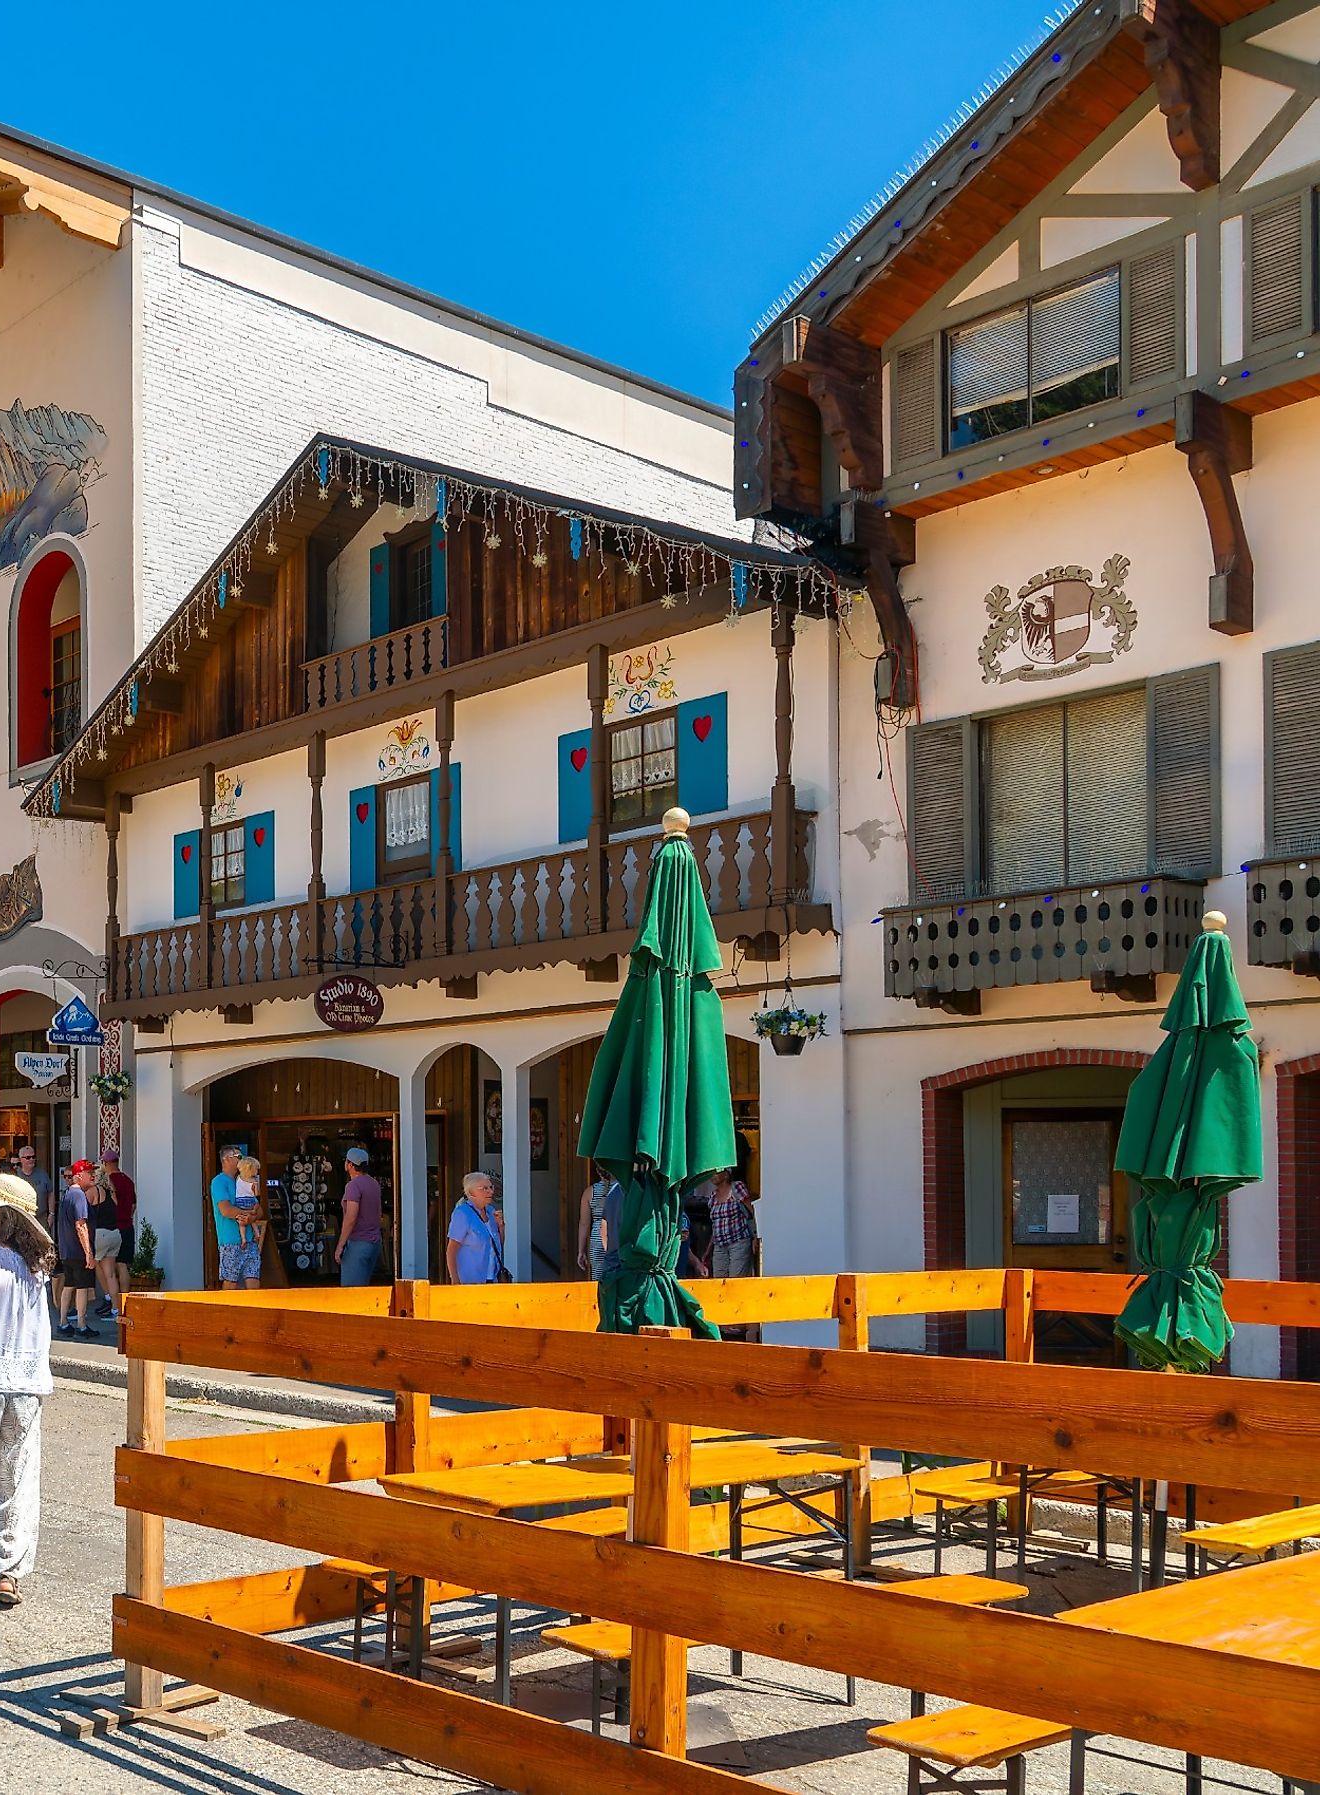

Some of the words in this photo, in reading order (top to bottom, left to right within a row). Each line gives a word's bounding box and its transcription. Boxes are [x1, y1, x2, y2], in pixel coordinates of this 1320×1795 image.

[320, 979, 354, 1006] Studio
[357, 983, 378, 1006] 1890
[326, 1011, 337, 1022] Old
[338, 1012, 352, 1022] Time
[353, 1012, 375, 1024] Photos
[23, 1057, 43, 1069] Alpen
[46, 1057, 63, 1069] Dorf
